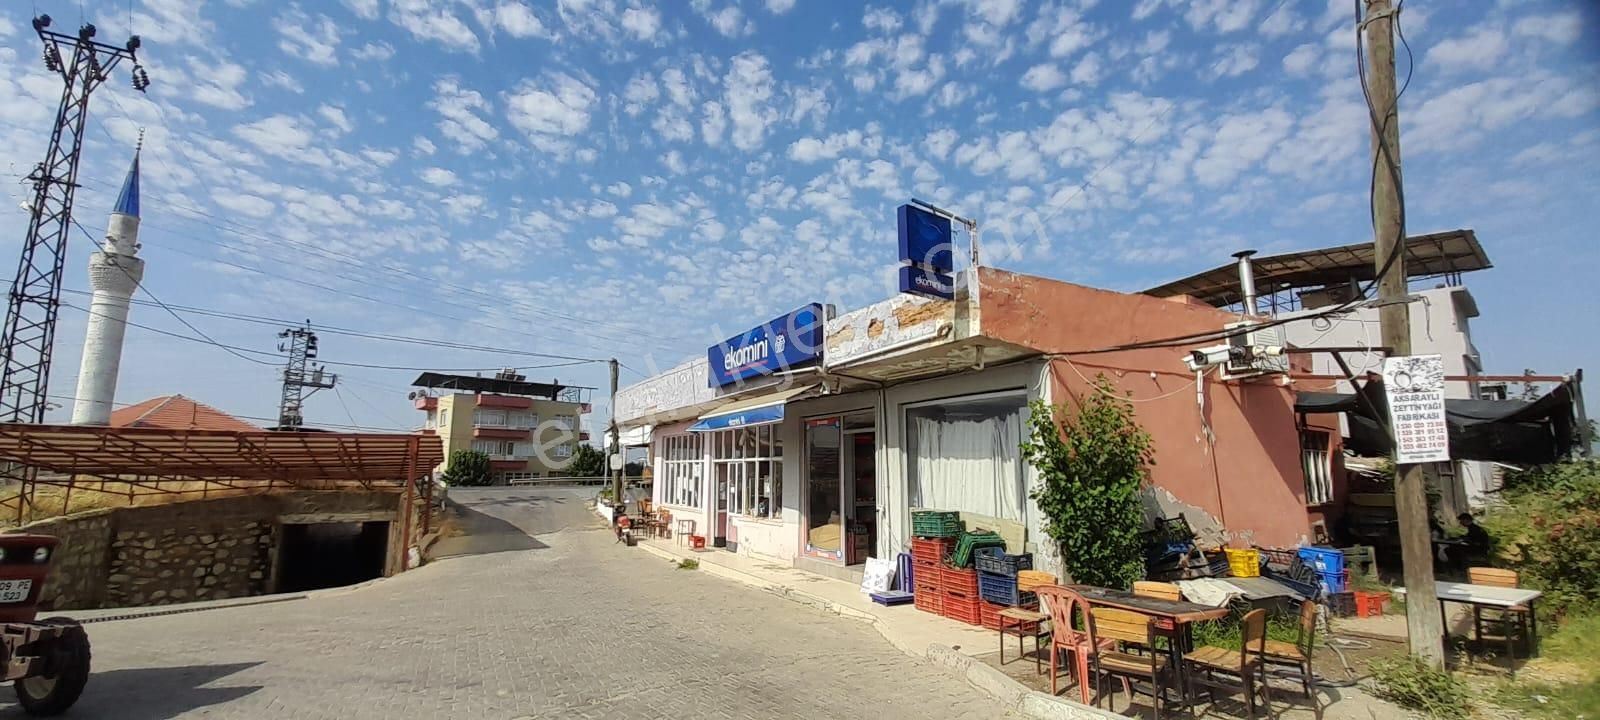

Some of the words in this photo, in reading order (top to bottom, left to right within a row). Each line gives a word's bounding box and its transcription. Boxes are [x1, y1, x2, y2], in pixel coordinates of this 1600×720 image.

[724, 331, 769, 370] ekomini
[1393, 393, 1441, 403] AKSARAYLI
[17, 581, 31, 590] PE
[4, 591, 21, 600] 523
